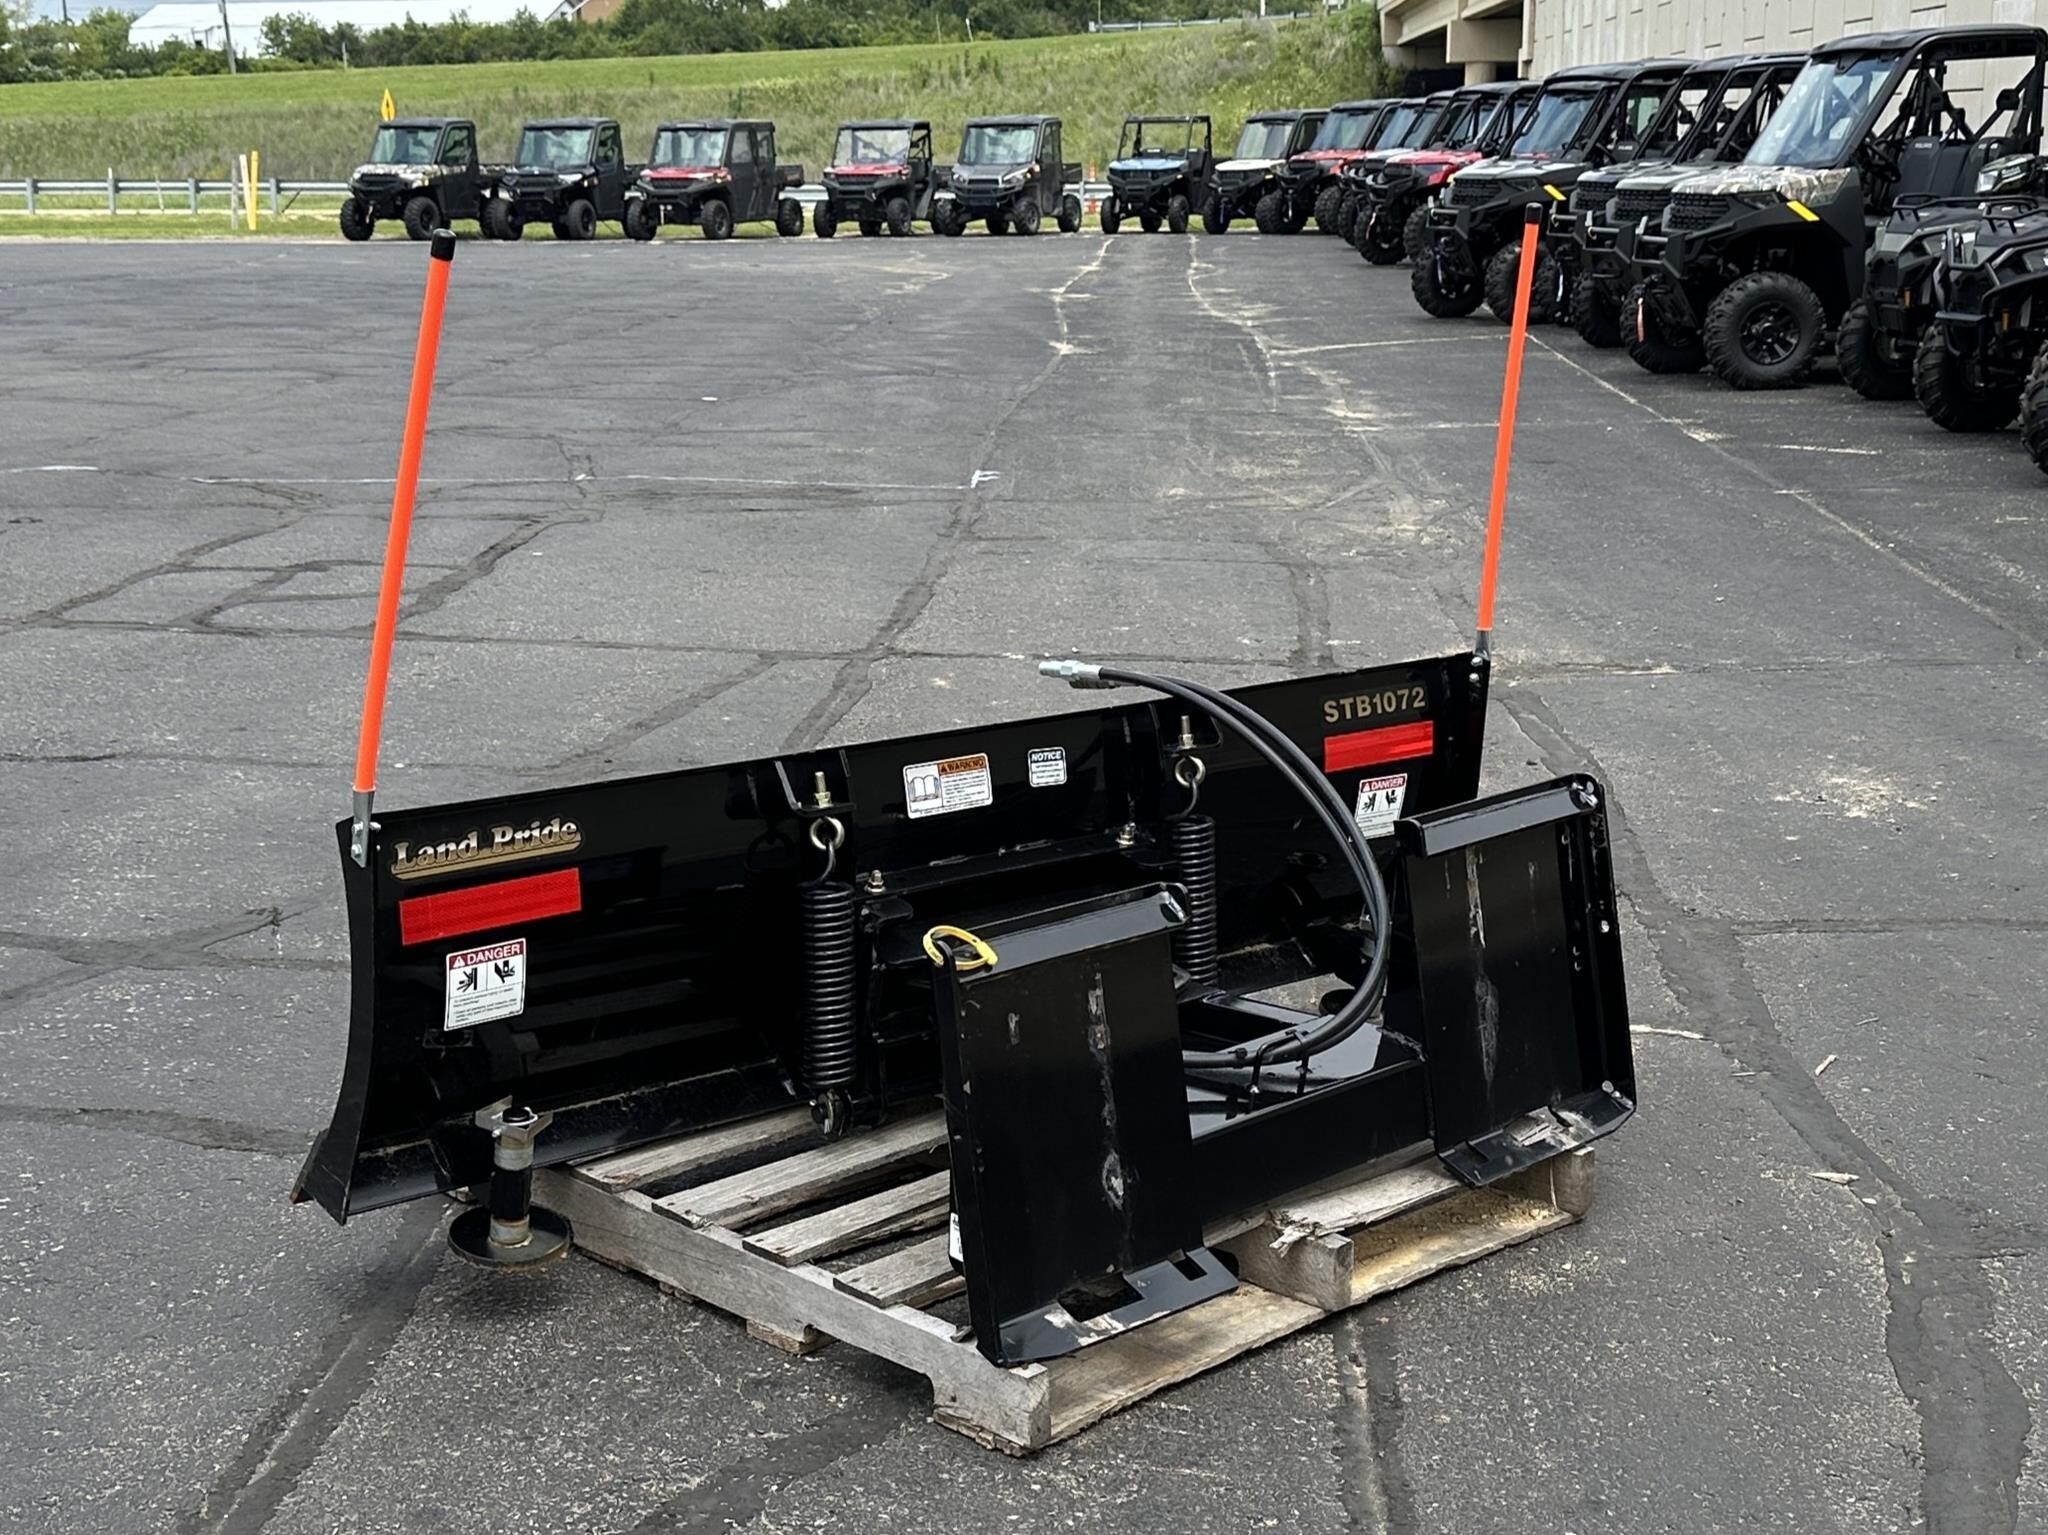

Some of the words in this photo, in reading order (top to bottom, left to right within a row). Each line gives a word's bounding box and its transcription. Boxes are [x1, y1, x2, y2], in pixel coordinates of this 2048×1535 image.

[1323, 686, 1426, 723] STB1072
[946, 759, 984, 772] WARNING
[1031, 751, 1062, 762] NOTICE
[1371, 777, 1404, 790] DANGER
[393, 831, 480, 871] Land
[486, 817, 581, 855] Pride
[466, 943, 521, 966] DANGER
